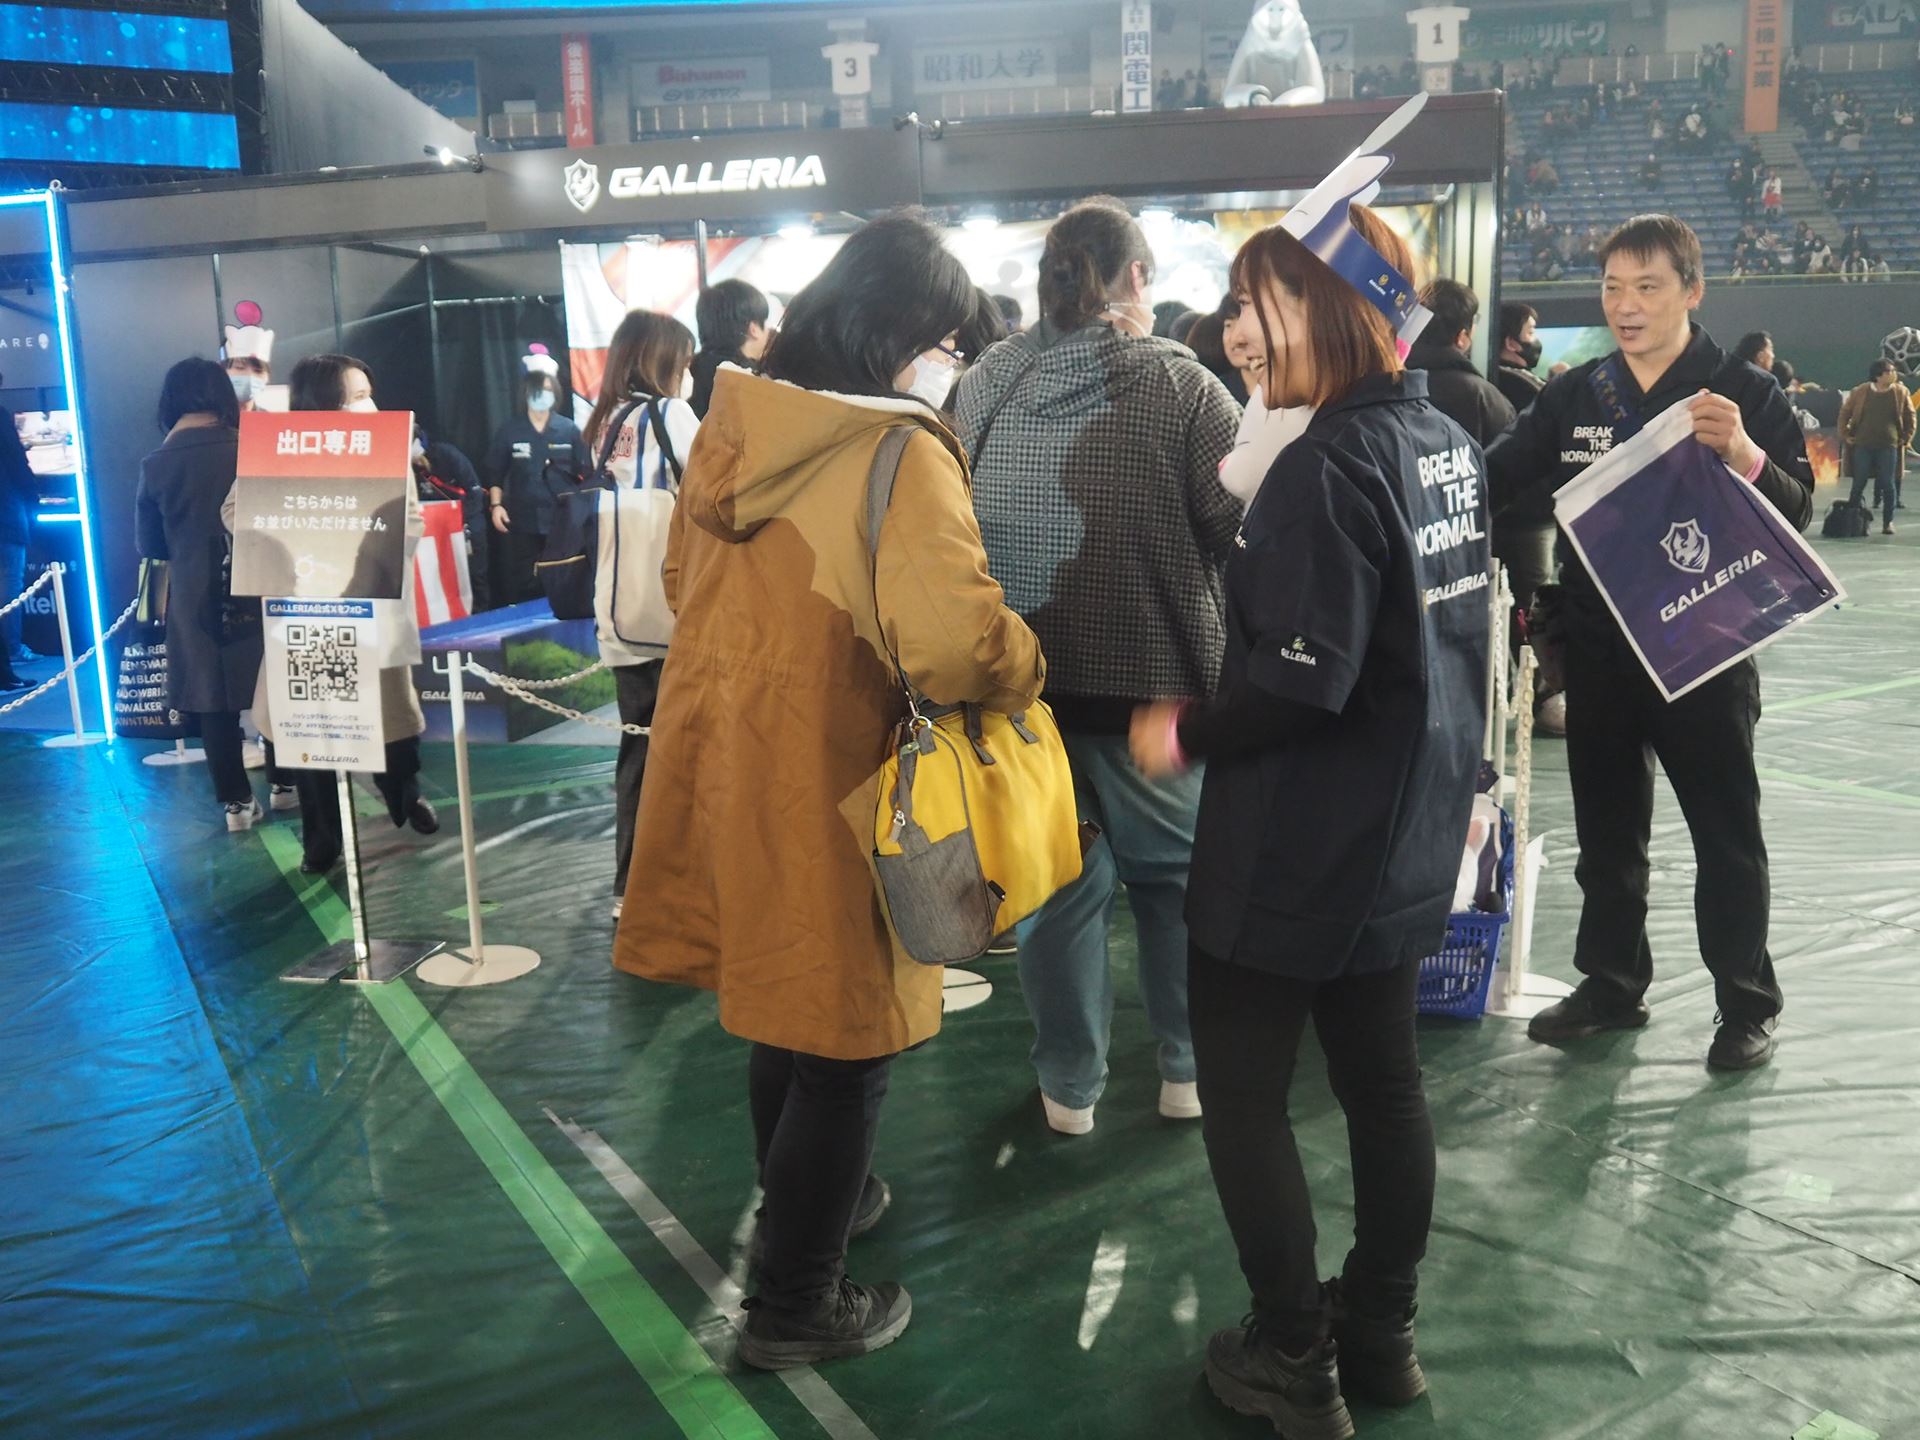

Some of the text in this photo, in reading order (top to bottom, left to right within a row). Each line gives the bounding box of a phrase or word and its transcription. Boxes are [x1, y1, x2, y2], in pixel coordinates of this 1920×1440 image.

[1433, 23, 1443, 44] 1
[1754, 5, 1776, 88] 三機工業
[844, 57, 857, 78] 3
[923, 48, 1044, 83] 昭和大学
[1123, 31, 1149, 110] 関電工
[566, 42, 589, 138] 後楽園ホール
[608, 154, 827, 199] GALLERIA
[276, 429, 372, 456] 出口専用
[1573, 425, 1614, 438] BREAK
[1561, 451, 1608, 463] NORMA
[1588, 439, 1612, 451] THE
[1418, 444, 1478, 488] BREAK
[283, 495, 357, 509] こちらからは
[1443, 477, 1479, 514] THE
[252, 514, 387, 531] お並びいただけません
[1660, 549, 1768, 623] GALLERIA
[421, 690, 486, 700] GALRIA
[311, 755, 360, 764] GALLERIA
